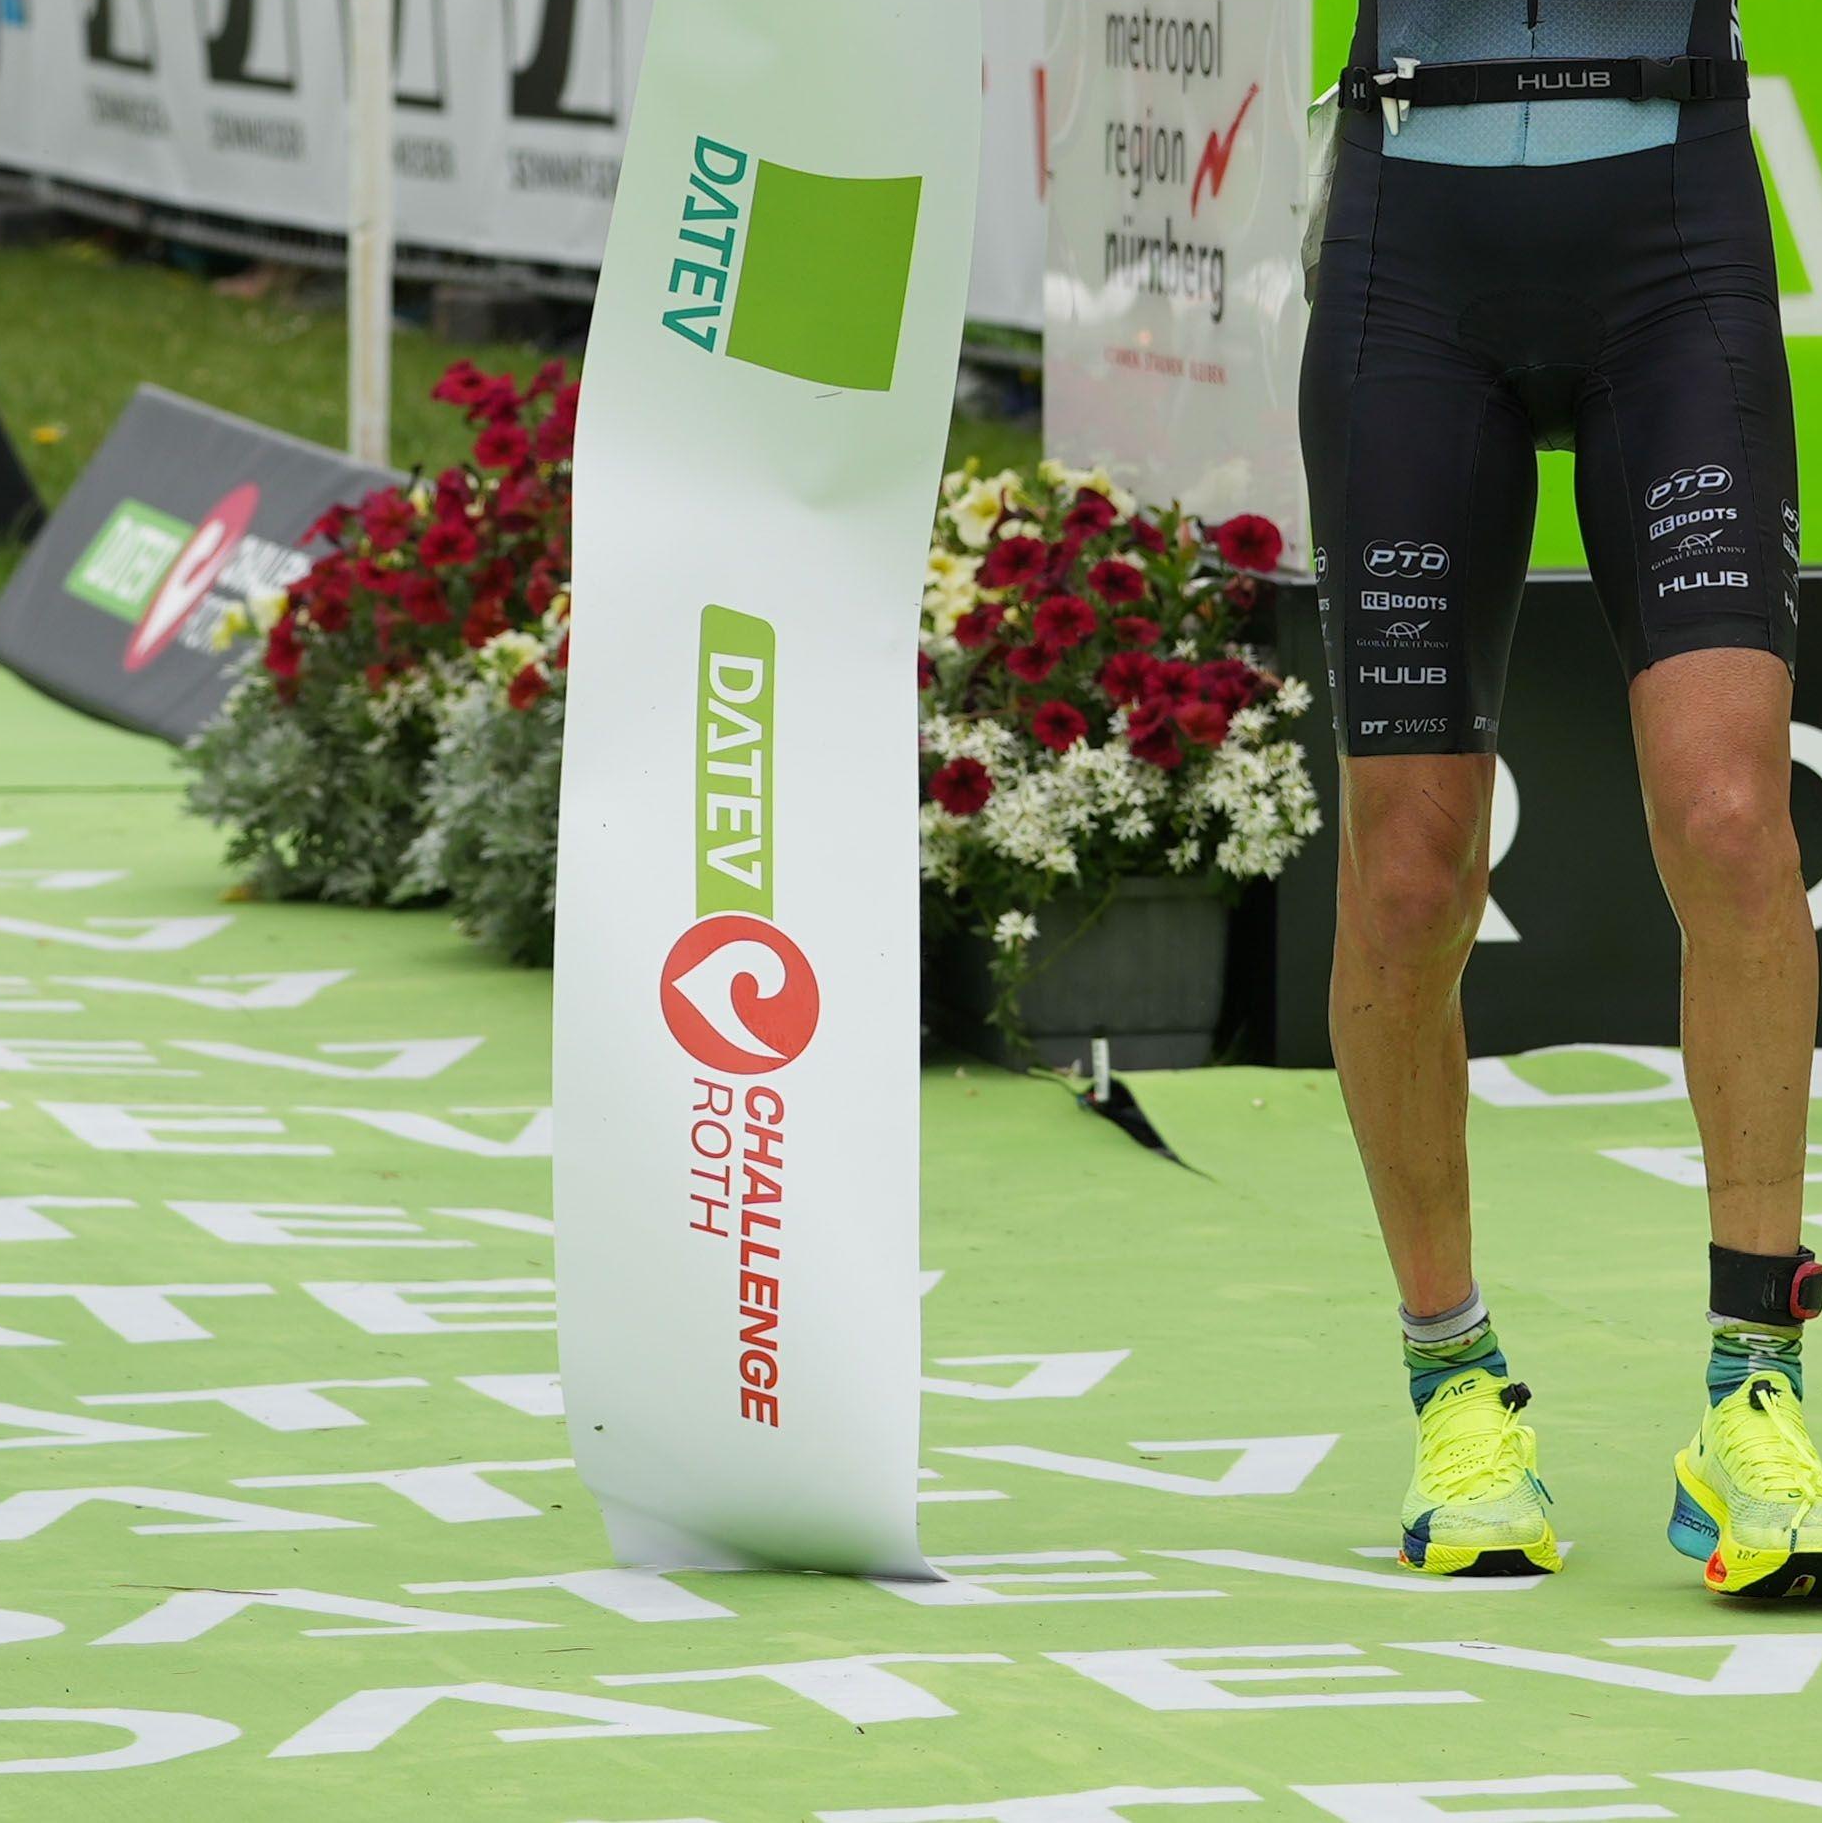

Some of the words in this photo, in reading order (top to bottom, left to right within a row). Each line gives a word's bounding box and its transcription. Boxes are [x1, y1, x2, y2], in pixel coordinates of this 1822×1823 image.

[1105, 0, 1225, 93] metropol
[1518, 71, 1611, 90] HUUB
[1105, 108, 1185, 198] region
[661, 134, 749, 356] DATEV
[1104, 216, 1225, 325] nürnberg
[1650, 472, 1725, 505] PTO
[1649, 507, 1738, 541] REBOOTS
[1370, 550, 1445, 570] PTO
[1361, 590, 1447, 611] REBOOTS
[1658, 570, 1749, 598] HUUB
[1359, 665, 1447, 685] HUUB
[1360, 720, 1389, 735] DT
[1394, 718, 1448, 734] SWISS
[705, 652, 764, 891] DATEV
[688, 1075, 734, 1239] ROTH
[738, 1083, 785, 1429] CHALLENGE
